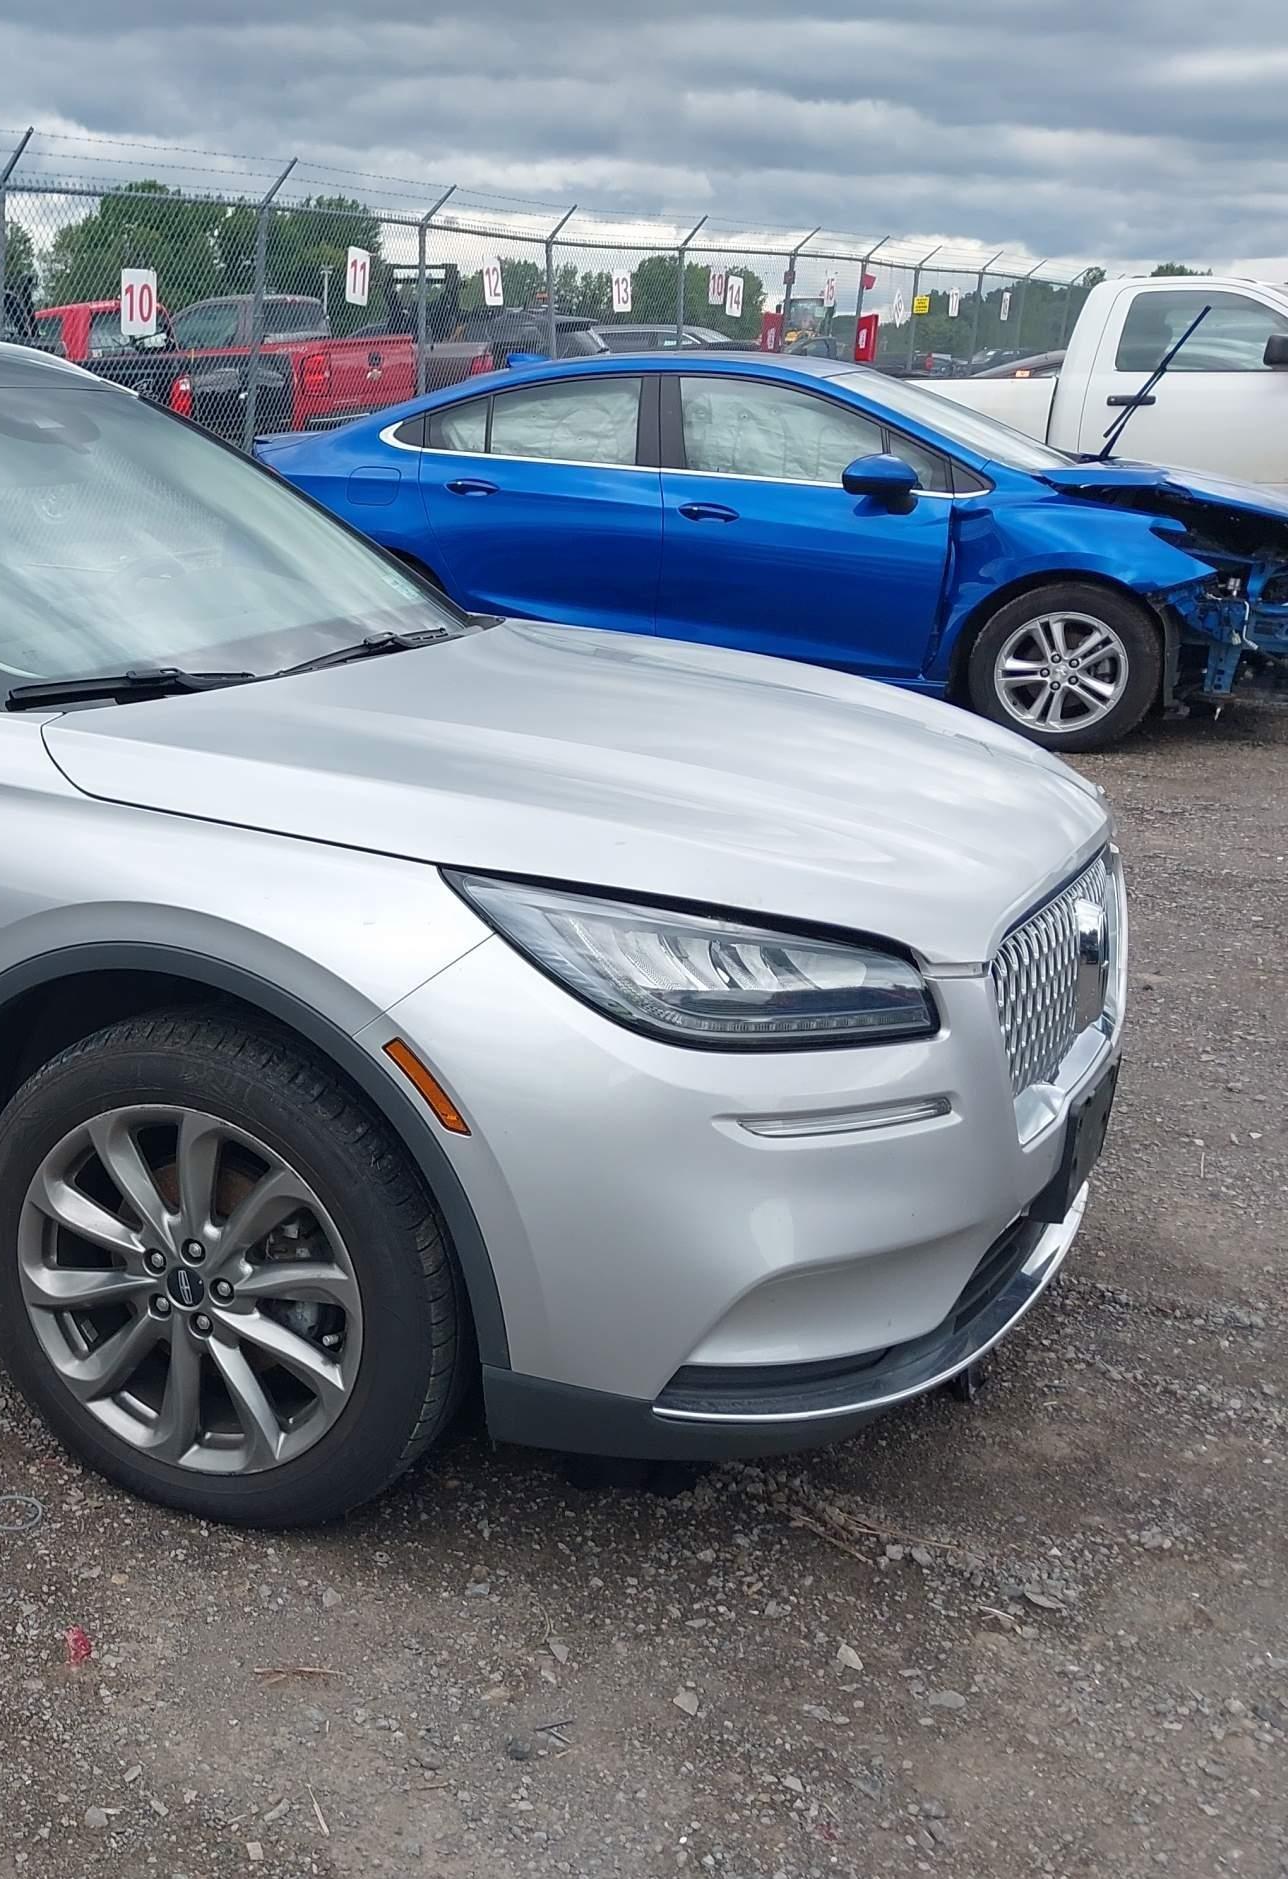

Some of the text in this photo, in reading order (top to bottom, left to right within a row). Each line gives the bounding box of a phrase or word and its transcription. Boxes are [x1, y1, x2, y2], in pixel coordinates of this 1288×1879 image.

[350, 259, 367, 297] 11
[485, 266, 501, 297] 12
[614, 277, 630, 305] 13
[711, 273, 724, 297] 10
[124, 283, 153, 322] 10
[728, 284, 741, 310] 14
